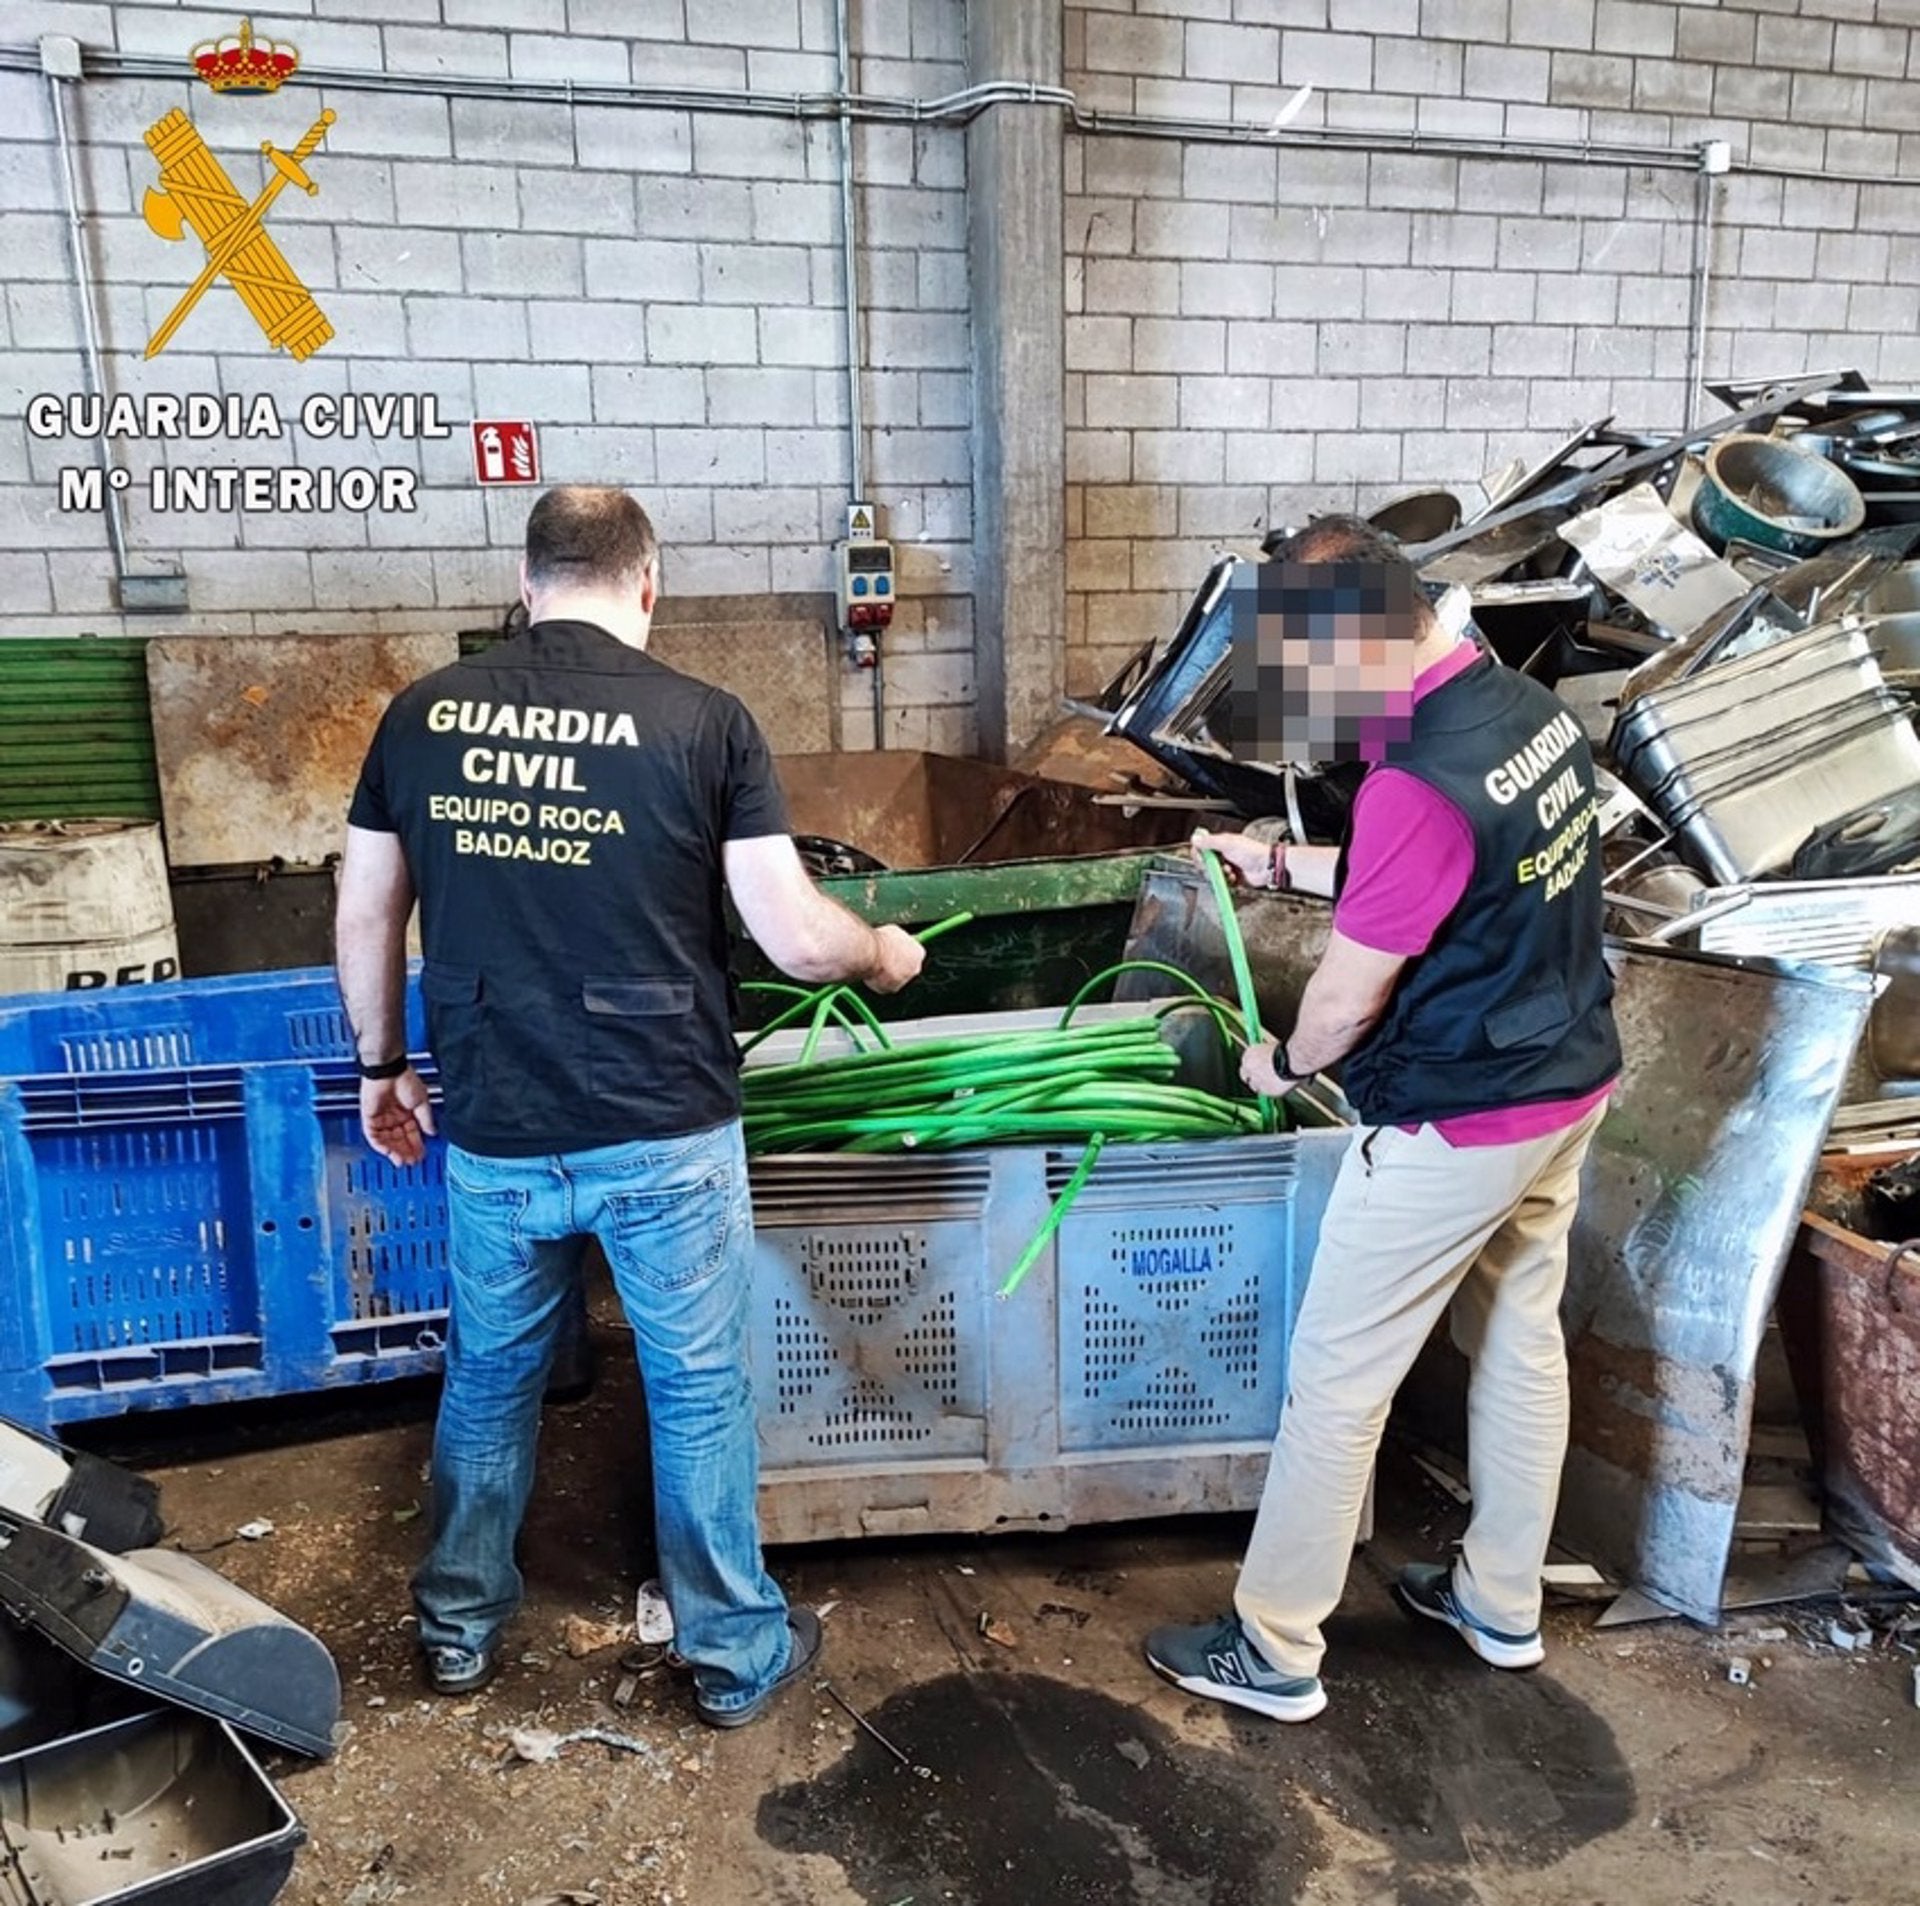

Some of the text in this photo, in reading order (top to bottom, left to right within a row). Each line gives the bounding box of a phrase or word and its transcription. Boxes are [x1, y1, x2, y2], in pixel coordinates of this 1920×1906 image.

[427, 699, 640, 747] GUARDIA
[462, 747, 587, 792] CIVIL
[1485, 710, 1583, 805] GUARDIA
[429, 795, 625, 835] EQUIPO ROCA
[1537, 765, 1586, 830] CIVIL
[456, 829, 591, 866] BADAJOZ
[1132, 1246, 1212, 1277] MOGALLA
